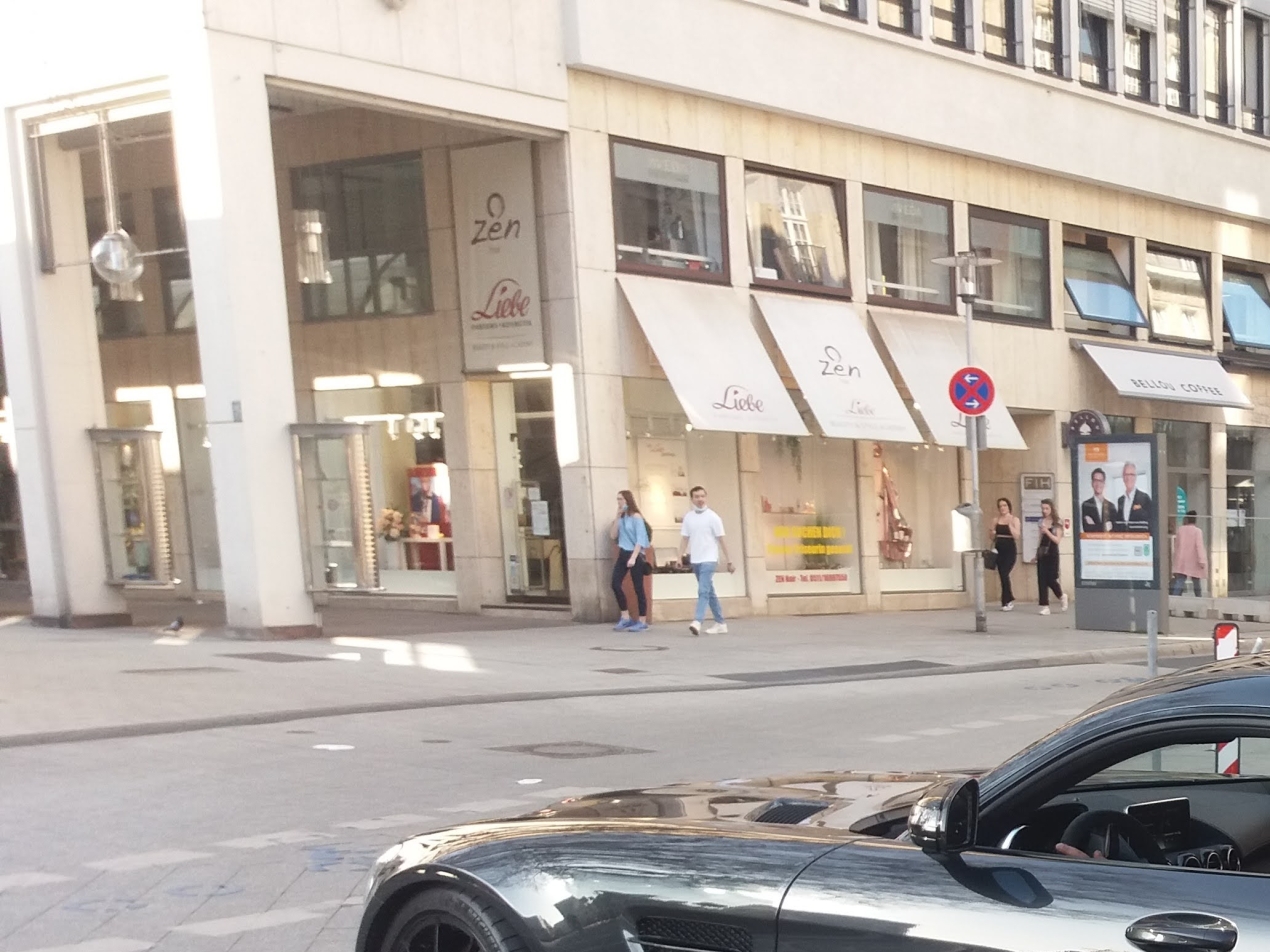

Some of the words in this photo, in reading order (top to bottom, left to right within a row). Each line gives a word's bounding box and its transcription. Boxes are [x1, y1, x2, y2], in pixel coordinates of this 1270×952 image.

[471, 278, 531, 321] Liebe
[712, 384, 765, 413] Liebe
[1130, 378, 1176, 391] BELLOU
[1180, 383, 1223, 396] COFFEE
